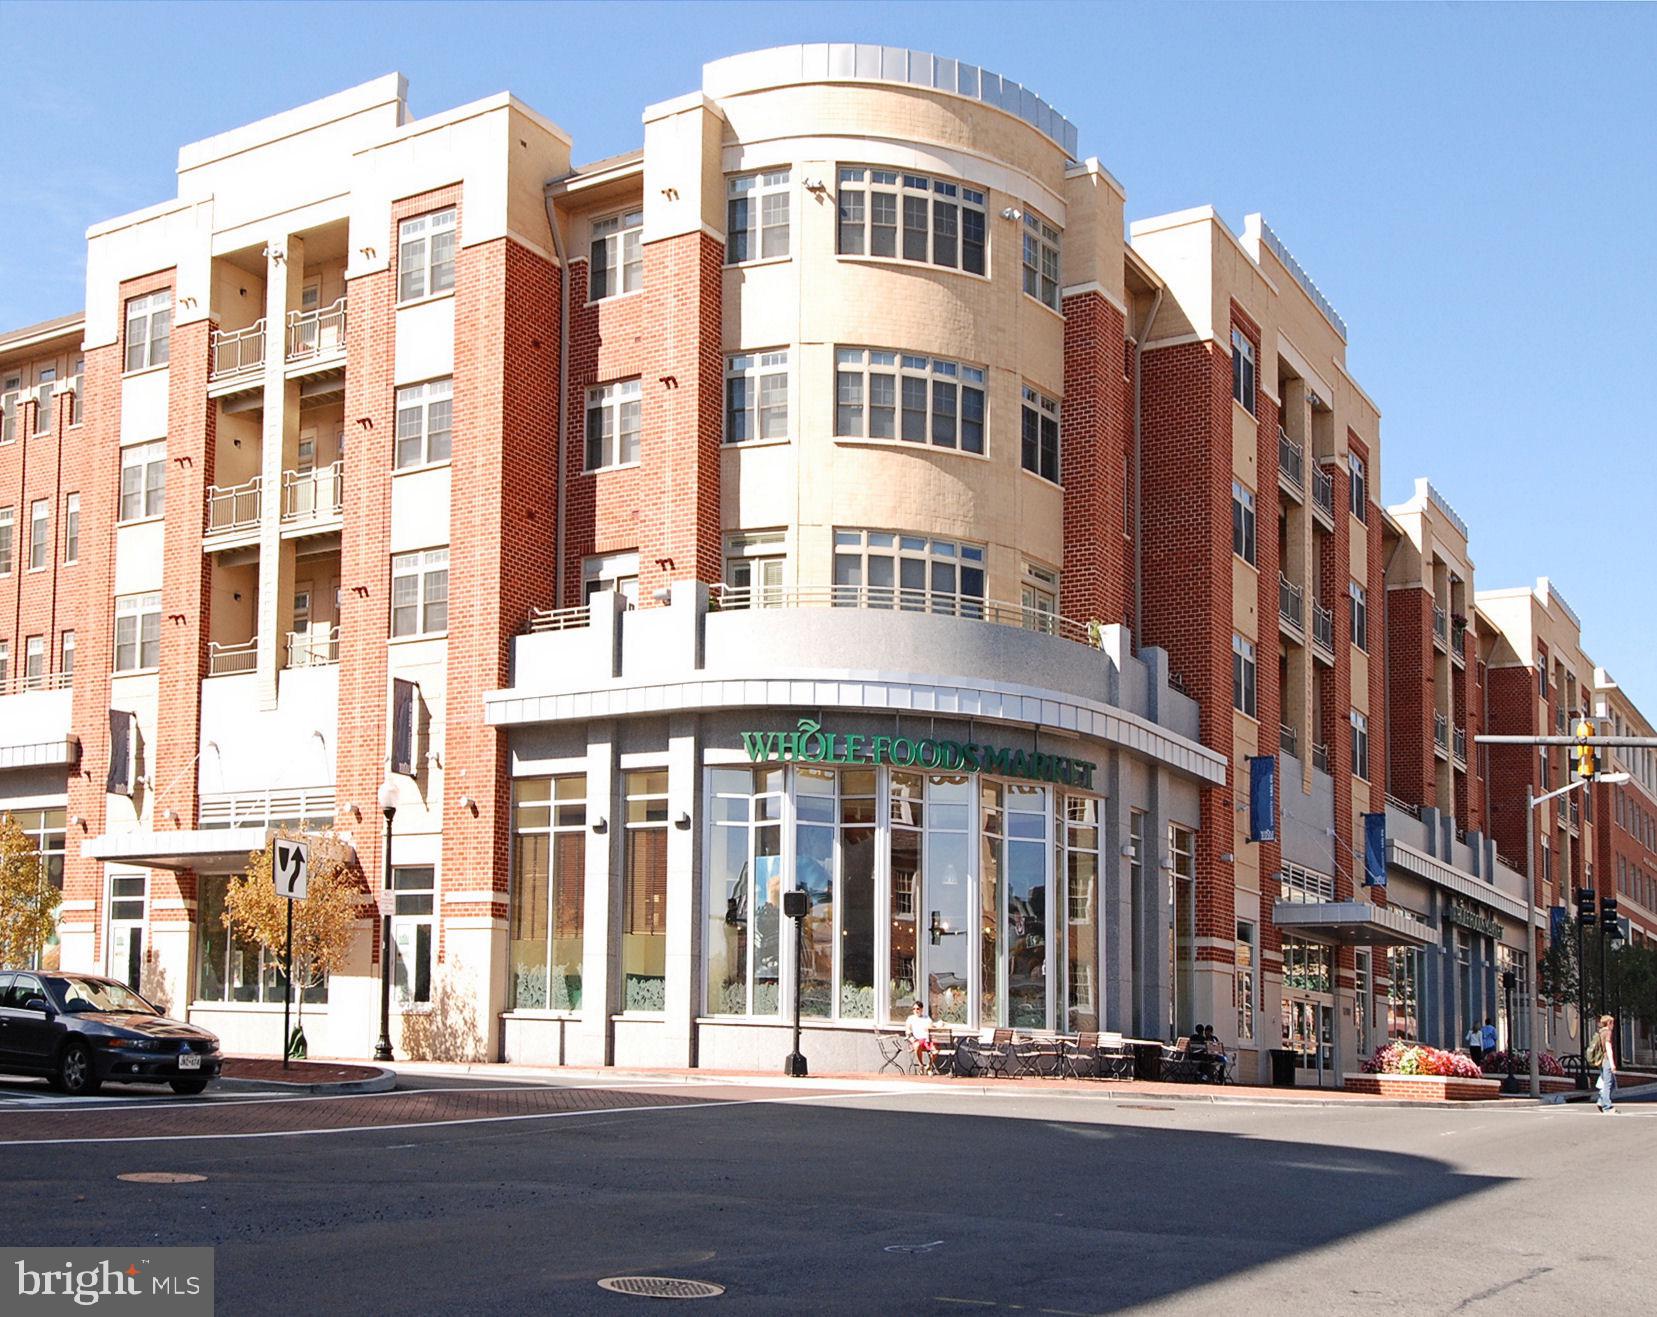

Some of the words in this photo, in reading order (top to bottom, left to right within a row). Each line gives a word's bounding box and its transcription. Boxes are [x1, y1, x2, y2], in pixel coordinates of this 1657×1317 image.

[740, 719, 866, 764] WHOLE
[871, 735, 981, 773] FOODS
[983, 745, 1097, 790] MARKET
